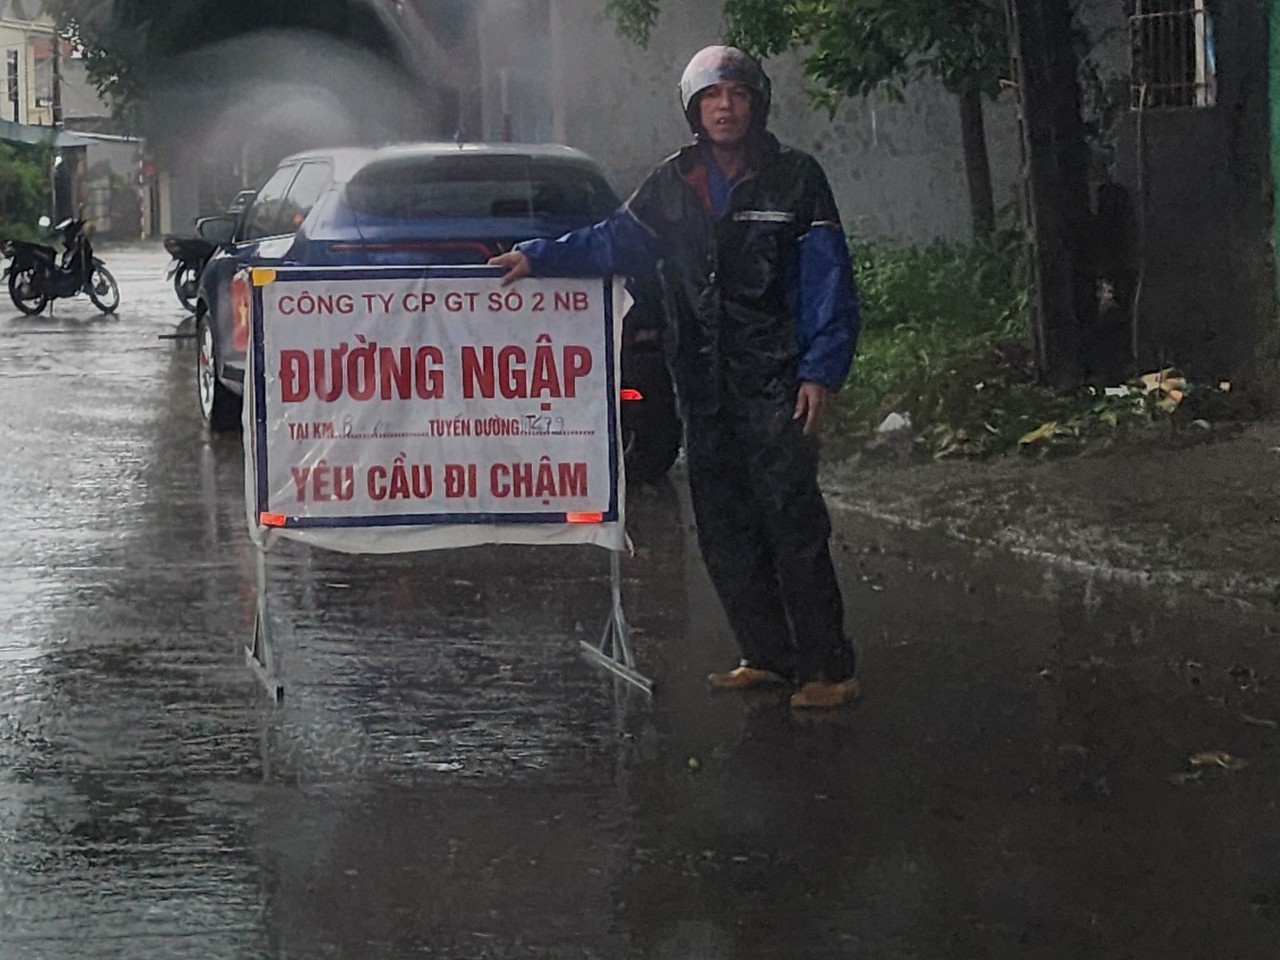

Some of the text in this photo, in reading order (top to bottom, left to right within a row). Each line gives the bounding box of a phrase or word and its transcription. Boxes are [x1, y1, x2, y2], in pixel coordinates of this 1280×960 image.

[278, 291, 354, 315] CÔNG
[362, 293, 394, 313] TY
[402, 292, 436, 312] CP
[444, 292, 479, 312] GT
[532, 292, 545, 312] 2
[554, 291, 588, 311] NB
[279, 333, 593, 411] ĐƯỜNG NGẬP
[291, 451, 588, 505] YÊU CẦU ĐI CHẬM
